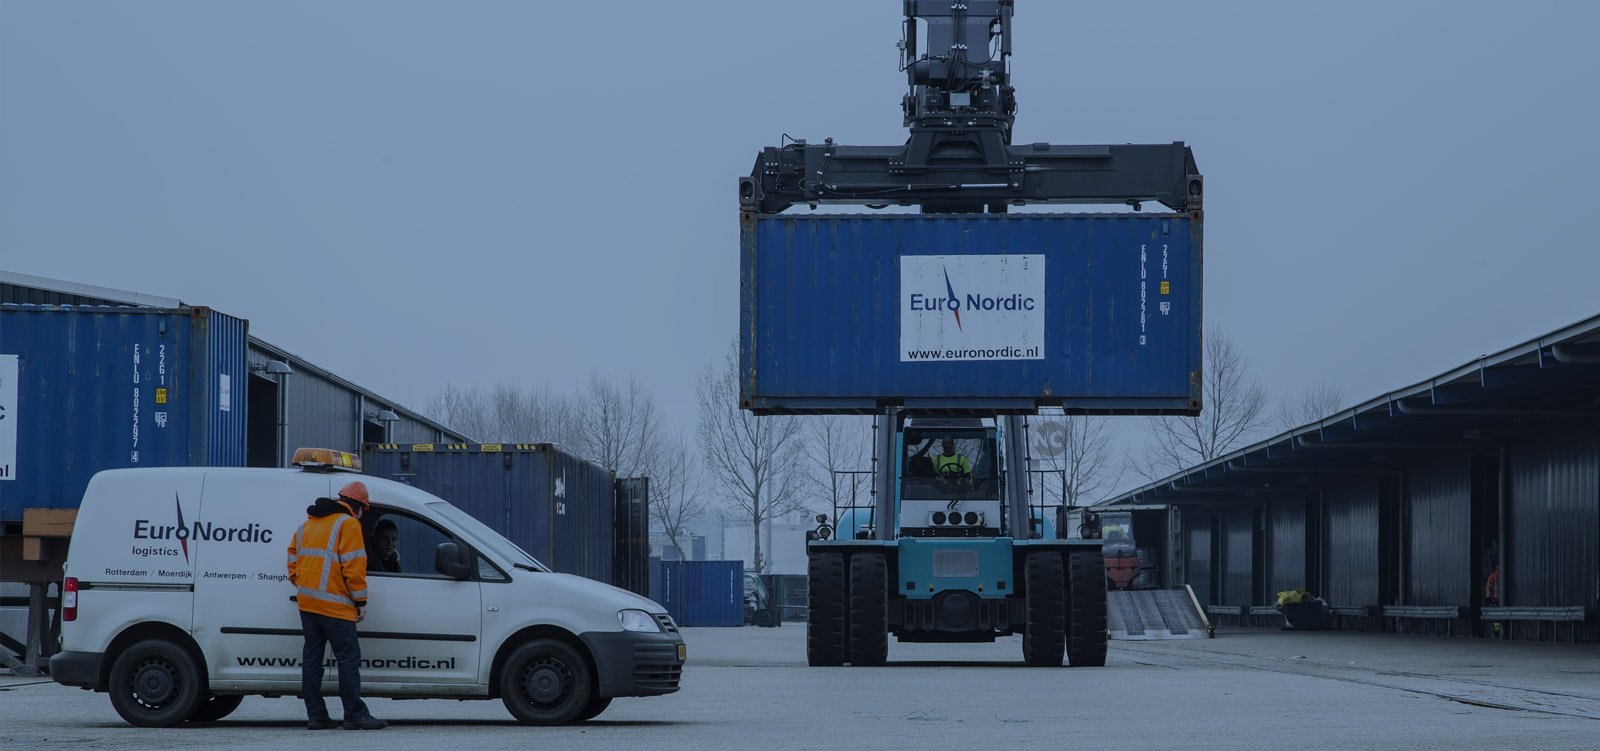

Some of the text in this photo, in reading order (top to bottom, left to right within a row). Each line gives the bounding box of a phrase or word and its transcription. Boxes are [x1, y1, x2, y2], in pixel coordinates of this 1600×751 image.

[910, 293, 1035, 311] Euro Nordic
[907, 346, 1039, 360] www.euronordic.nl
[132, 387, 140, 448] 802297
[131, 545, 179, 558] logistics
[105, 568, 148, 577] Rotterdam
[158, 569, 193, 578] Moerdijk
[203, 571, 247, 580] Antwerpen
[258, 572, 290, 583] Shangh
[236, 656, 456, 670] www.urnordic.nl
